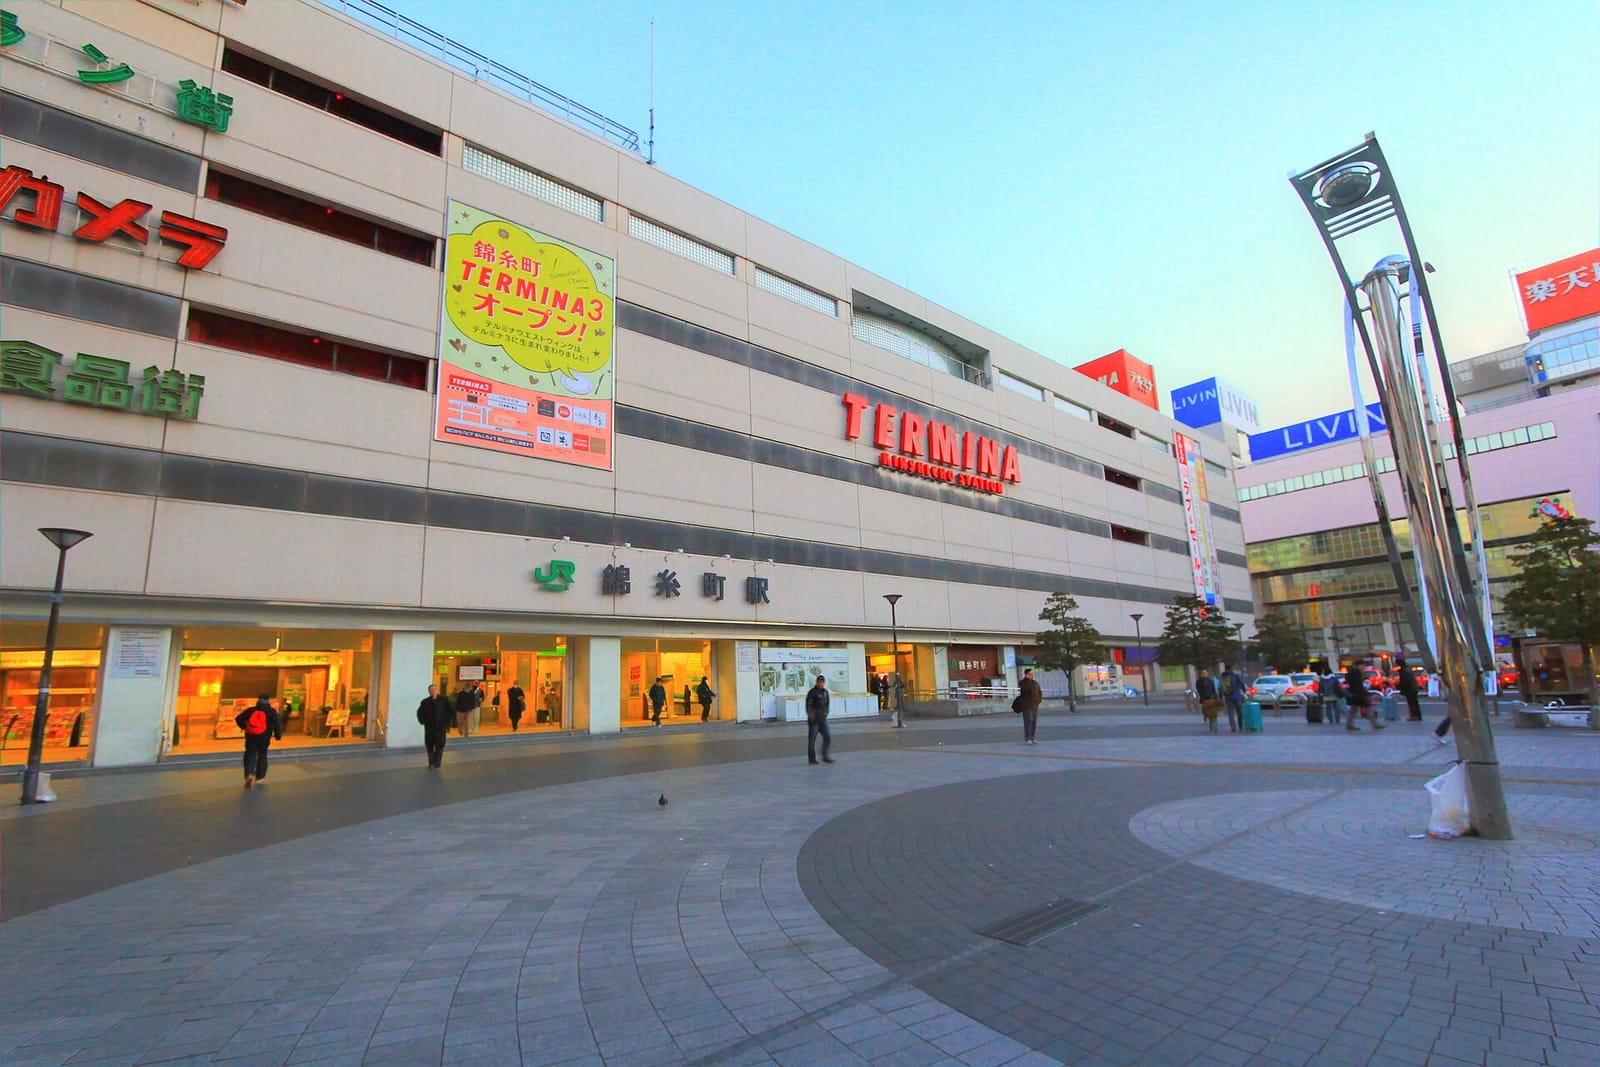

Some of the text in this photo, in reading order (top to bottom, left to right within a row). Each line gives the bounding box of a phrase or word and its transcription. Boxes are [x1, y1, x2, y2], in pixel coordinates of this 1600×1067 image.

[0, 165, 228, 270] カメラ
[474, 240, 541, 277] 錦糸町
[461, 260, 604, 321] TERMINA3
[1525, 262, 1600, 304] 楽天
[0, 340, 205, 420] 食品街
[1174, 388, 1217, 410] LIVIN
[1219, 385, 1259, 426] LIVIN
[842, 392, 1021, 483] TERMINA
[879, 452, 1004, 494] KINSHICHO STATION
[535, 560, 770, 605] JR 錦糸町駅
